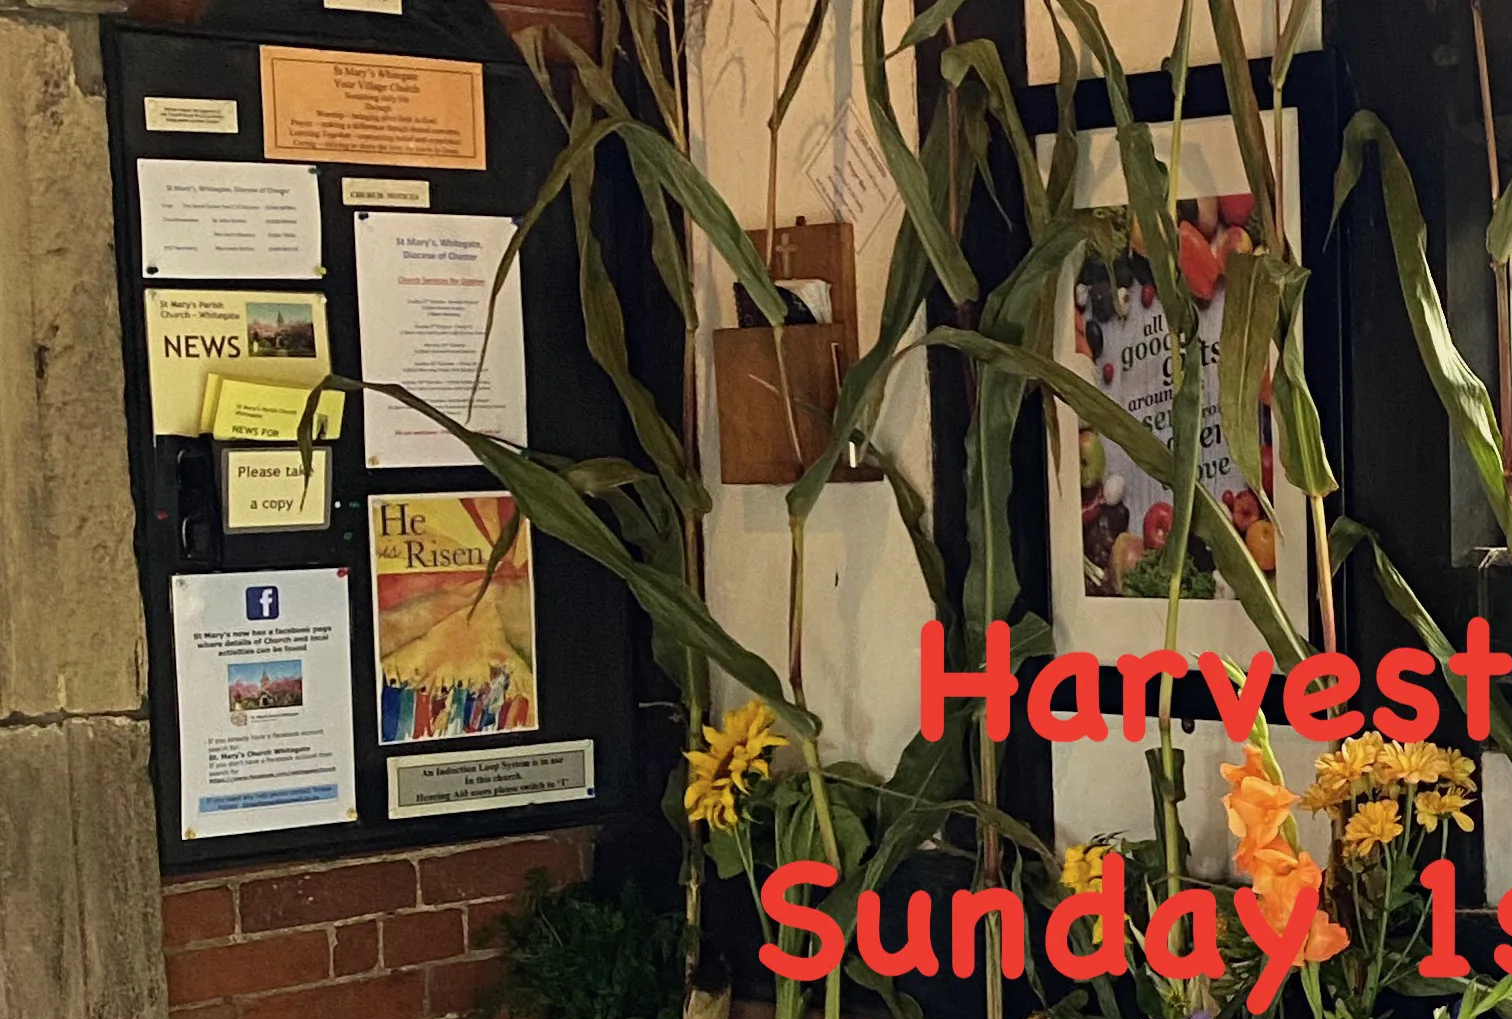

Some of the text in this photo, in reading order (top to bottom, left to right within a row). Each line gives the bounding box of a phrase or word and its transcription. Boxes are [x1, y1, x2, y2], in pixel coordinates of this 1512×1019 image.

[389, 83, 421, 94] Church
[403, 251, 437, 260] Diocese
[160, 300, 224, 310] St Mary's Parish
[160, 311, 191, 319] Church
[198, 311, 240, 321] Whitegate
[1144, 314, 1164, 337] all
[164, 335, 241, 359] NEWS
[1163, 337, 1221, 387] gts
[1128, 388, 1173, 412] aroun
[232, 425, 280, 437] NEWS FOR
[238, 465, 315, 478] Please tak
[250, 499, 294, 512] a copy
[379, 503, 426, 537] He
[403, 540, 485, 569] Risen
[193, 632, 202, 640] St
[204, 632, 231, 640] Mary's
[312, 626, 332, 634] page
[197, 641, 223, 649] where
[224, 639, 252, 647] details
[264, 637, 292, 645] Church
[293, 635, 309, 643] and
[218, 648, 255, 657] activities
[221, 752, 245, 760] Mary's
[247, 750, 272, 758] Church
[274, 746, 311, 754] Whitegate
[422, 769, 434, 777] An
[436, 766, 477, 776] Induction
[479, 763, 500, 772] Loop
[501, 760, 530, 770] System
[540, 758, 549, 766] in
[550, 757, 564, 765] use
[476, 775, 491, 784] this
[416, 793, 451, 803] Hearing
[453, 789, 469, 798] Aid
[470, 788, 492, 797] users
[494, 785, 518, 797] please
[520, 782, 545, 791] switch
[547, 780, 556, 789] to
